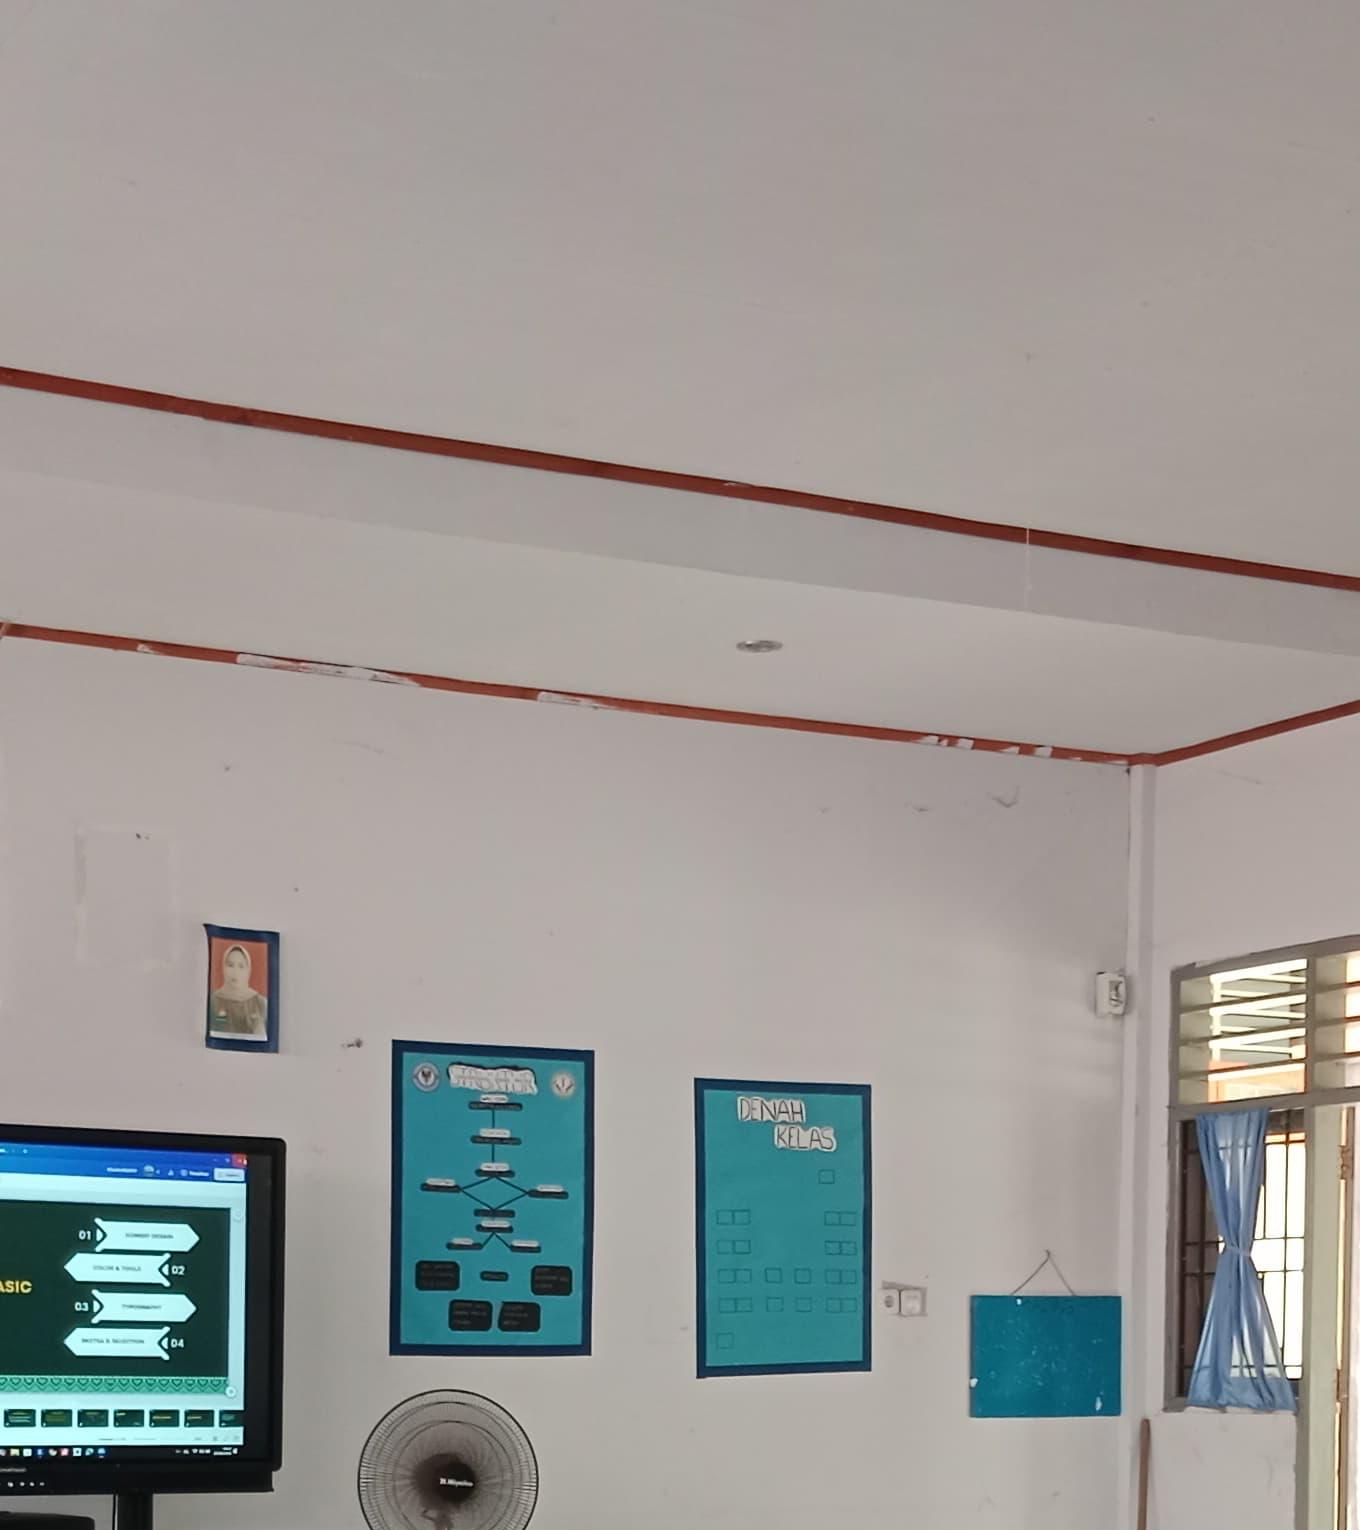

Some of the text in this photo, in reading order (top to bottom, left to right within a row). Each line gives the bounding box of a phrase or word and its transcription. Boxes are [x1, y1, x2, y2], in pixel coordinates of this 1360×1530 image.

[740, 1096, 804, 1121] DENAH
[776, 1126, 834, 1150] KELAS
[78, 1230, 92, 1240] 01
[171, 1265, 185, 1276] 02
[74, 1302, 89, 1312] 03
[170, 1338, 185, 1348] 04
